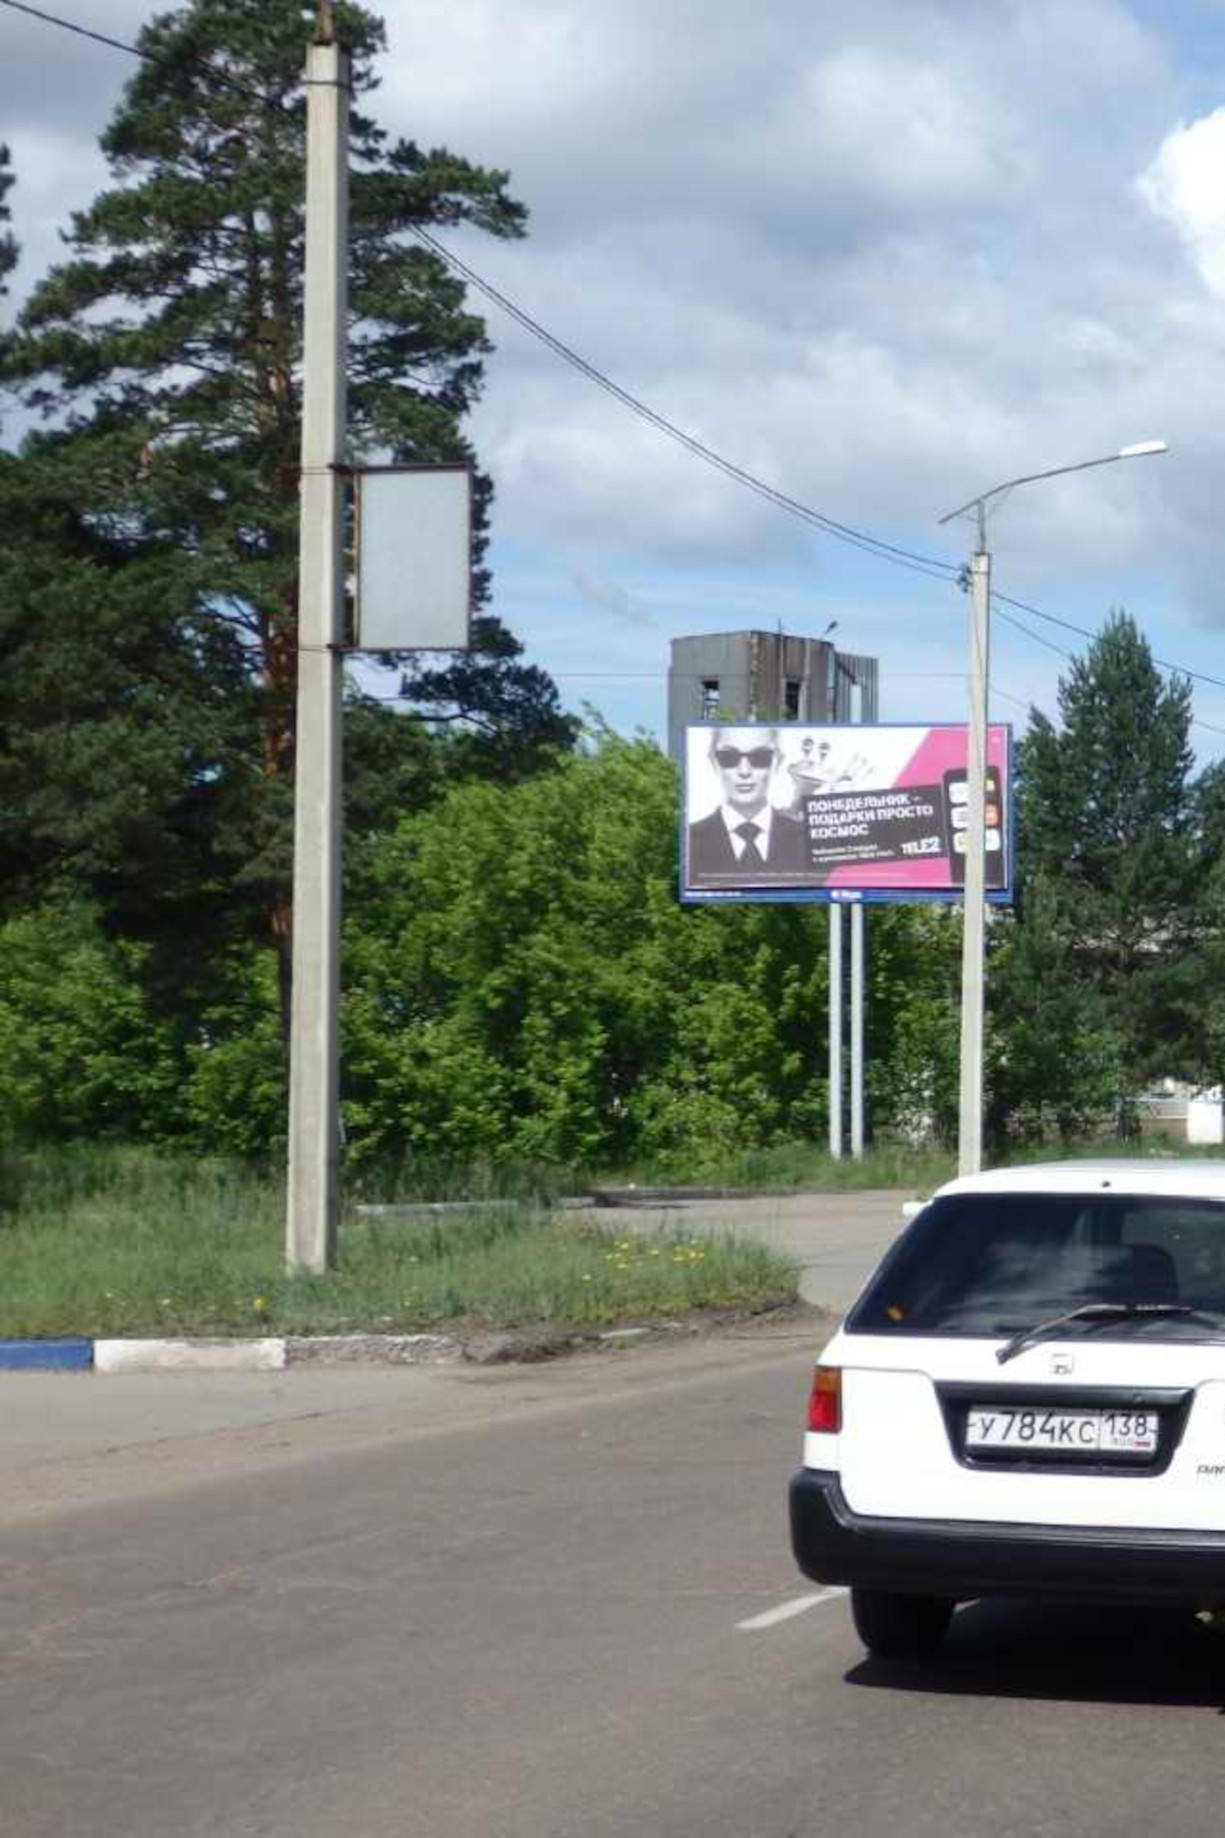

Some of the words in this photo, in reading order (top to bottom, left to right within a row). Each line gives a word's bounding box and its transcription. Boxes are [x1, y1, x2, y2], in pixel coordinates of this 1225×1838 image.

[807, 793, 911, 812] ПОНЕДЕЛЬНИК
[809, 809, 875, 826] ПОДАРКИ
[877, 804, 934, 820] ПРОСТО
[811, 824, 869, 840] КОСМОС
[980, 1410, 1095, 1444] У784КС
[1104, 1412, 1147, 1437] 138
